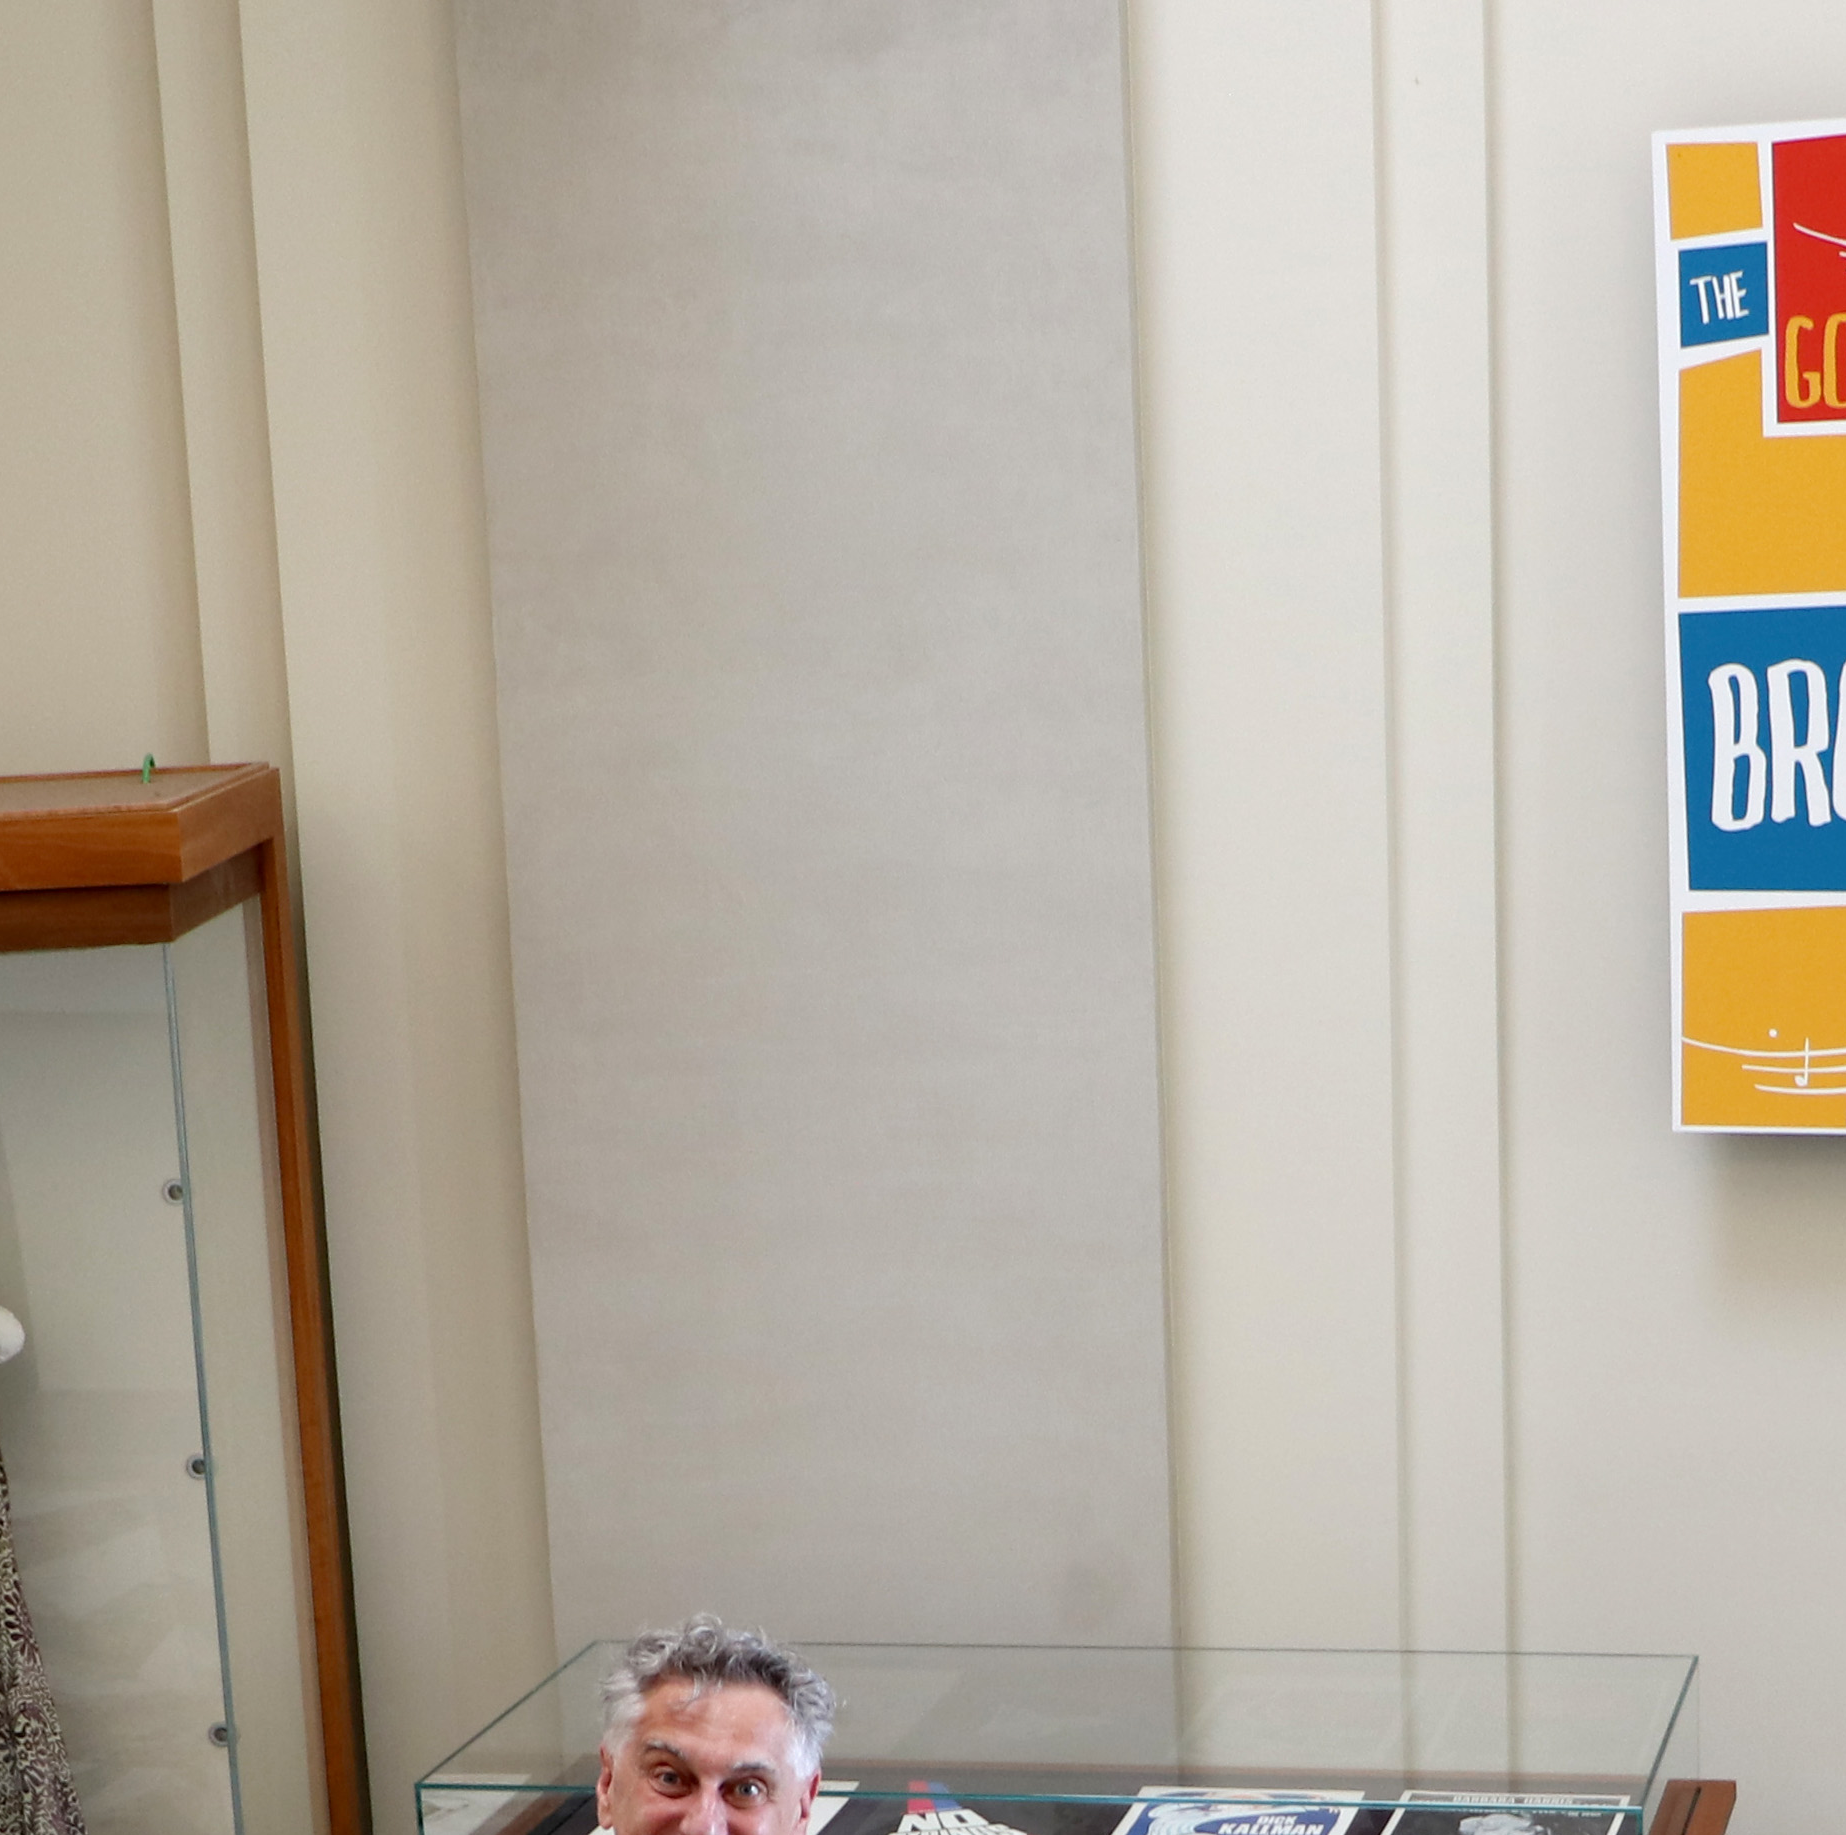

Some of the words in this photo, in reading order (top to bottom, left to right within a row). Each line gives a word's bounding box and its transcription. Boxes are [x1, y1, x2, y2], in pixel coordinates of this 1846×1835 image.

[1691, 271, 1749, 324] THE
[898, 1808, 990, 1833] NO
[1256, 1815, 1297, 1825] DICK
